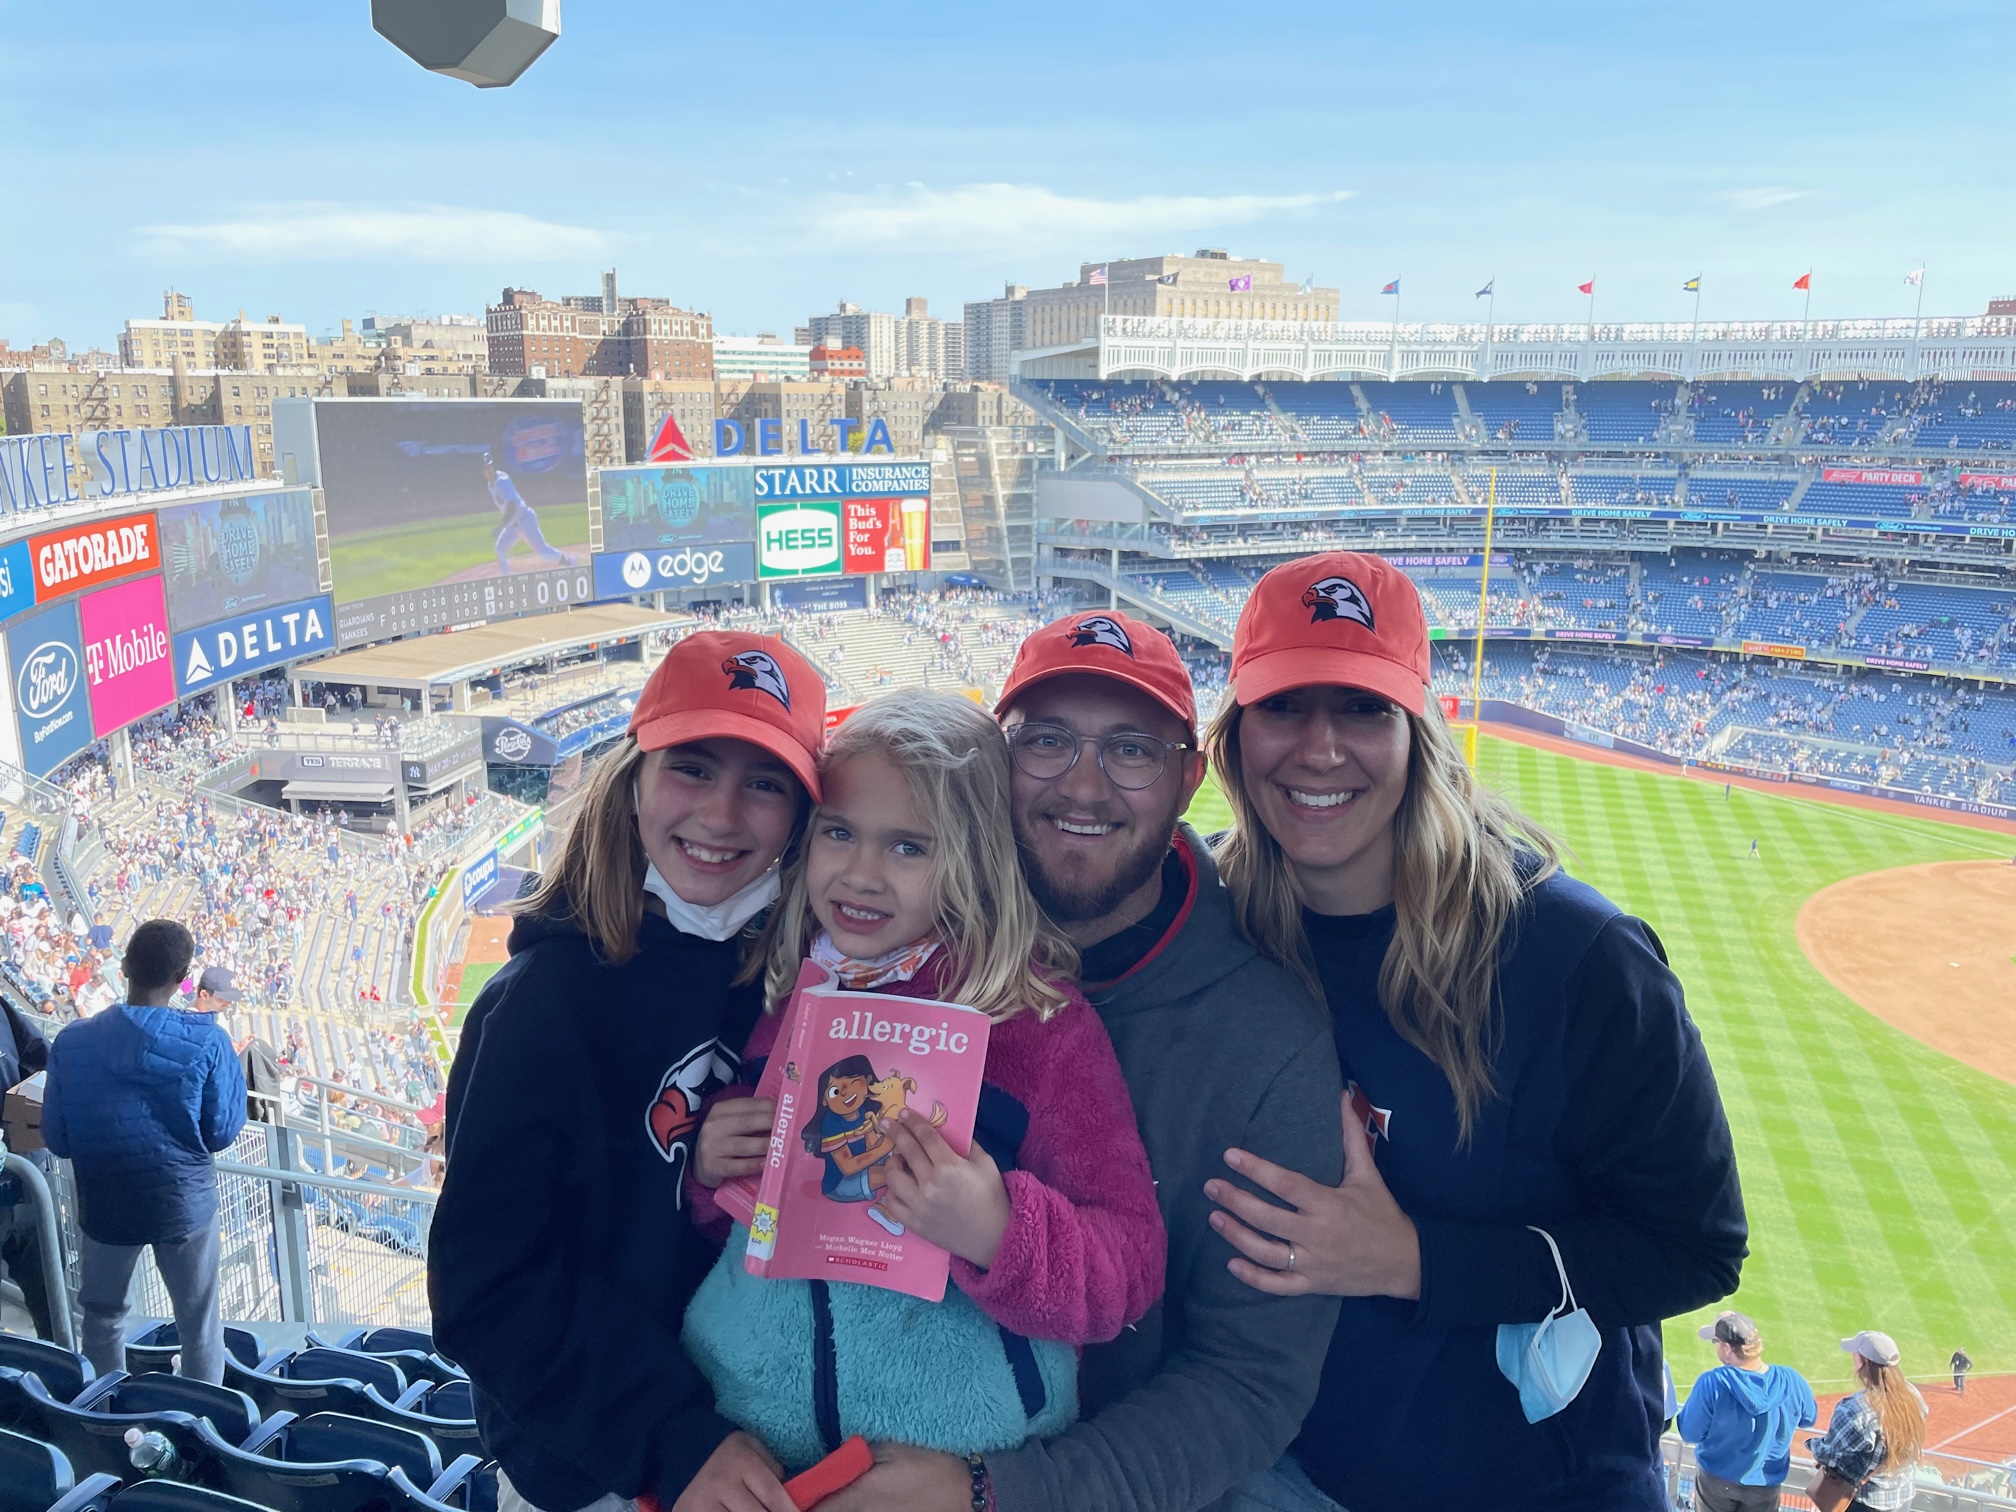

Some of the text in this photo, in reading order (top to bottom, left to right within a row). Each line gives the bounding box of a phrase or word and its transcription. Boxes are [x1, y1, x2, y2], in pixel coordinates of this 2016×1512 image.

[712, 417, 895, 458] DELTA
[96, 425, 256, 496] STADIUM
[755, 468, 843, 496] STARR
[852, 466, 930, 480] INSURANCE
[1862, 471, 1890, 482] PARTY
[1892, 472, 1916, 484] DECK
[852, 478, 930, 492] COMPANIES
[2002, 478, 2016, 488] PA
[664, 487, 695, 498] DRIVE
[665, 498, 694, 508] HOME
[848, 504, 876, 517] This
[664, 508, 695, 520] SAFELY
[848, 517, 882, 530] Bud's
[1764, 516, 1788, 524] DRIVE
[1790, 517, 1816, 525] HOME
[1817, 518, 1848, 528] SAFELY
[1970, 528, 1999, 536] DRIVE
[223, 526, 253, 542] DRIVE
[766, 528, 833, 552] HESS
[848, 531, 870, 543] For
[38, 522, 150, 588] GATORADE
[225, 541, 254, 560] HOME
[848, 544, 876, 556] You.
[224, 556, 256, 574] SAFELY
[658, 548, 724, 584] edge
[1406, 556, 1432, 566] HOME
[1434, 556, 1470, 566] SAFELY
[537, 576, 588, 604] 0 0 0
[339, 612, 375, 628] GUARDIANS
[391, 606, 396, 616] 0
[400, 604, 405, 614] 0
[409, 602, 414, 612] 0
[423, 600, 427, 609] 0
[432, 598, 436, 608] 2
[441, 597, 445, 606] 0
[454, 594, 459, 603] 0
[464, 593, 468, 602] 2
[472, 591, 477, 600] 0
[509, 586, 514, 594] 0
[522, 584, 526, 592] 1
[813, 601, 848, 611] THE BOSS
[340, 598, 527, 642] YANKEES 0 0 0 0 2 0 1 0 2 5 9 0 5
[218, 608, 324, 668] DELTA
[1866, 657, 1885, 665] DRIVE
[30, 652, 68, 710] Ford
[34, 710, 74, 744] BuyFordNow.com
[329, 757, 381, 768] TERRACE
[428, 764, 440, 777] MAY
[1914, 794, 2008, 817] YANKEE STADIUM
[472, 856, 495, 886] coupa
[828, 1010, 969, 1056] allergic
[769, 1093, 794, 1168] allergic
[819, 1234, 902, 1252] Megan Wagner Lloyd
[825, 1244, 858, 1253] Michelle
[860, 1247, 876, 1255] Mee
[878, 1250, 904, 1261] Nutter
[835, 1257, 886, 1270] SCHOLASTIC
